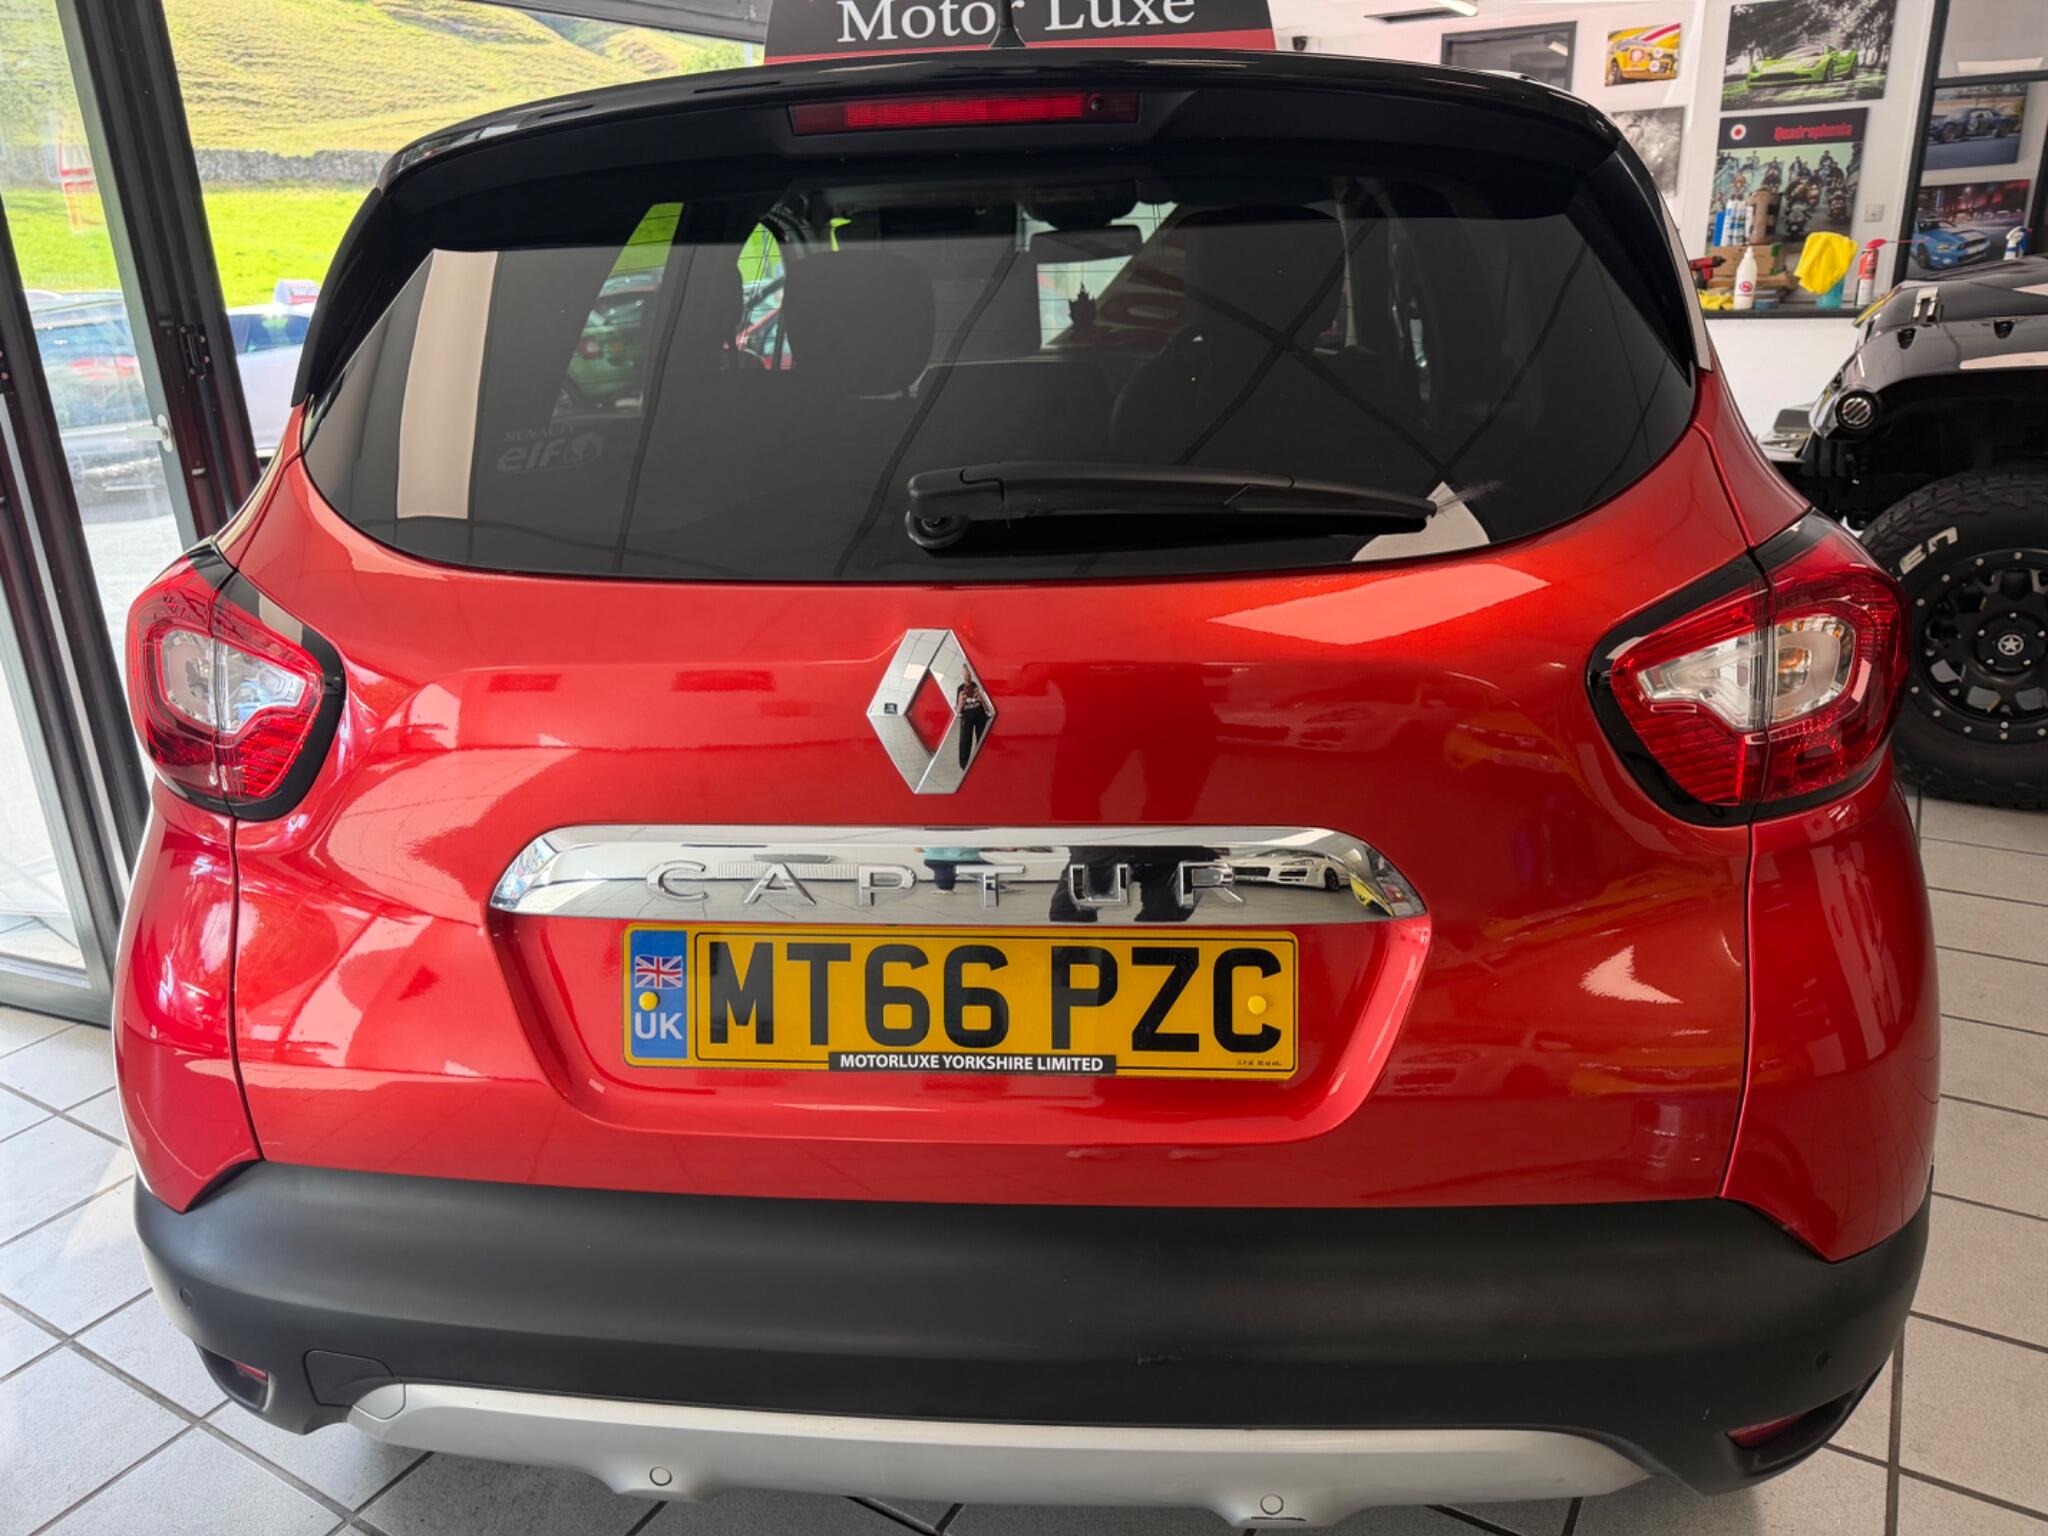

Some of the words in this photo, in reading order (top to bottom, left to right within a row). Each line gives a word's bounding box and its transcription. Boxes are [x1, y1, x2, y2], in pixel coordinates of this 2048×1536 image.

[1044, 0, 1195, 31] Luxe
[503, 423, 576, 442] RENAULT
[496, 438, 567, 472] elf
[646, 858, 1245, 909] CAPTUR
[709, 941, 1009, 1049] MT66
[1050, 945, 1282, 1054] PZC
[633, 1011, 684, 1041] UK
[840, 1053, 940, 1070] MOTORLUXE
[943, 1055, 1034, 1072] YORKSHIRE
[1036, 1056, 1104, 1073] LIMITED
